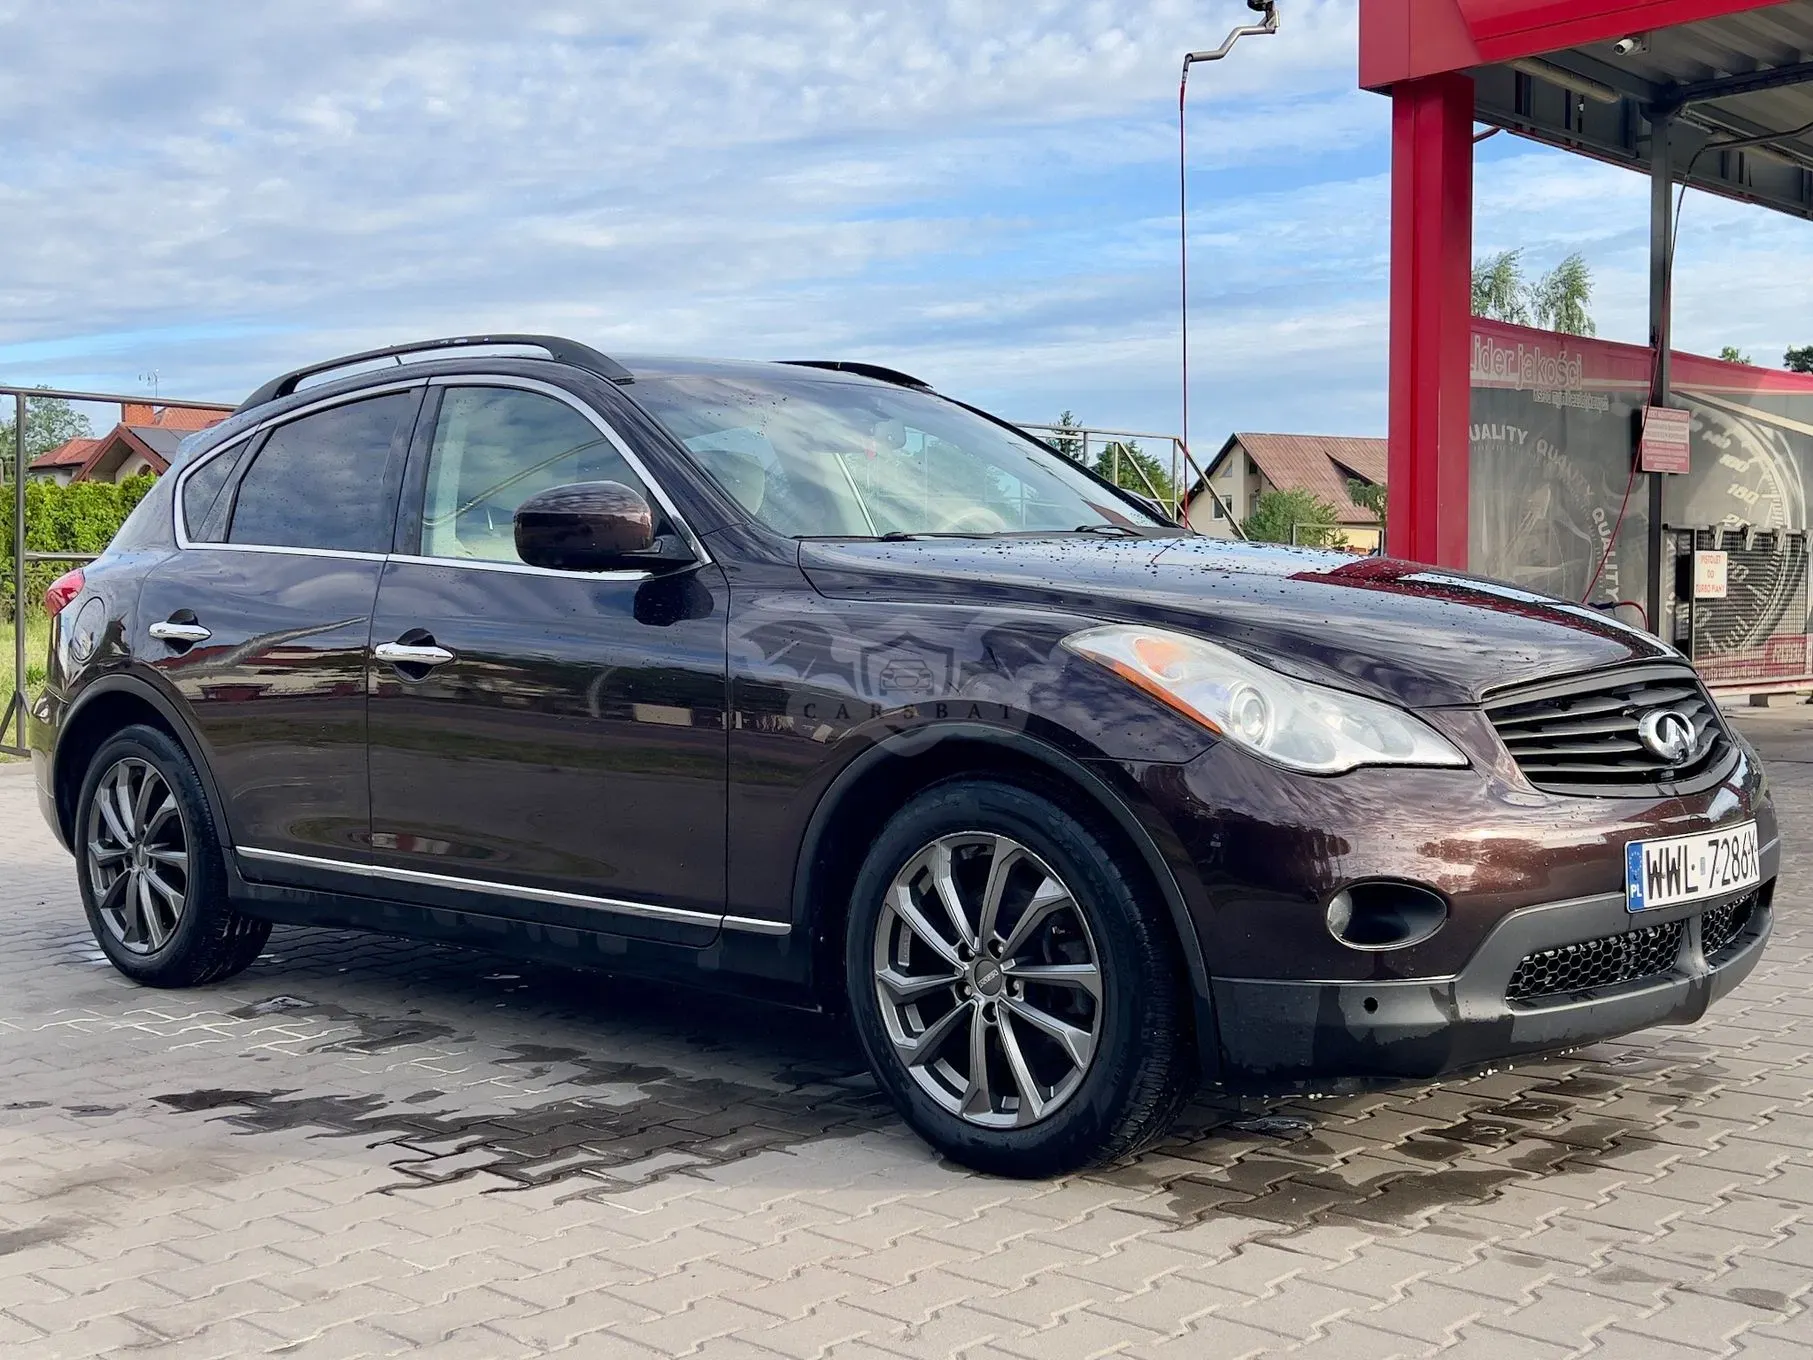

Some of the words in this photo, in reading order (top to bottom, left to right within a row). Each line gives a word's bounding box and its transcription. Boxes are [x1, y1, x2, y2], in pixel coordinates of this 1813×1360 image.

[1470, 335, 1514, 377] ider
[1515, 344, 1582, 390] jakości
[1469, 424, 1528, 445] UALITY
[1592, 507, 1620, 602] QUALITY
[1630, 883, 1643, 898] PL
[1646, 845, 1699, 900] WWL
[1708, 830, 1758, 889] 7286X
